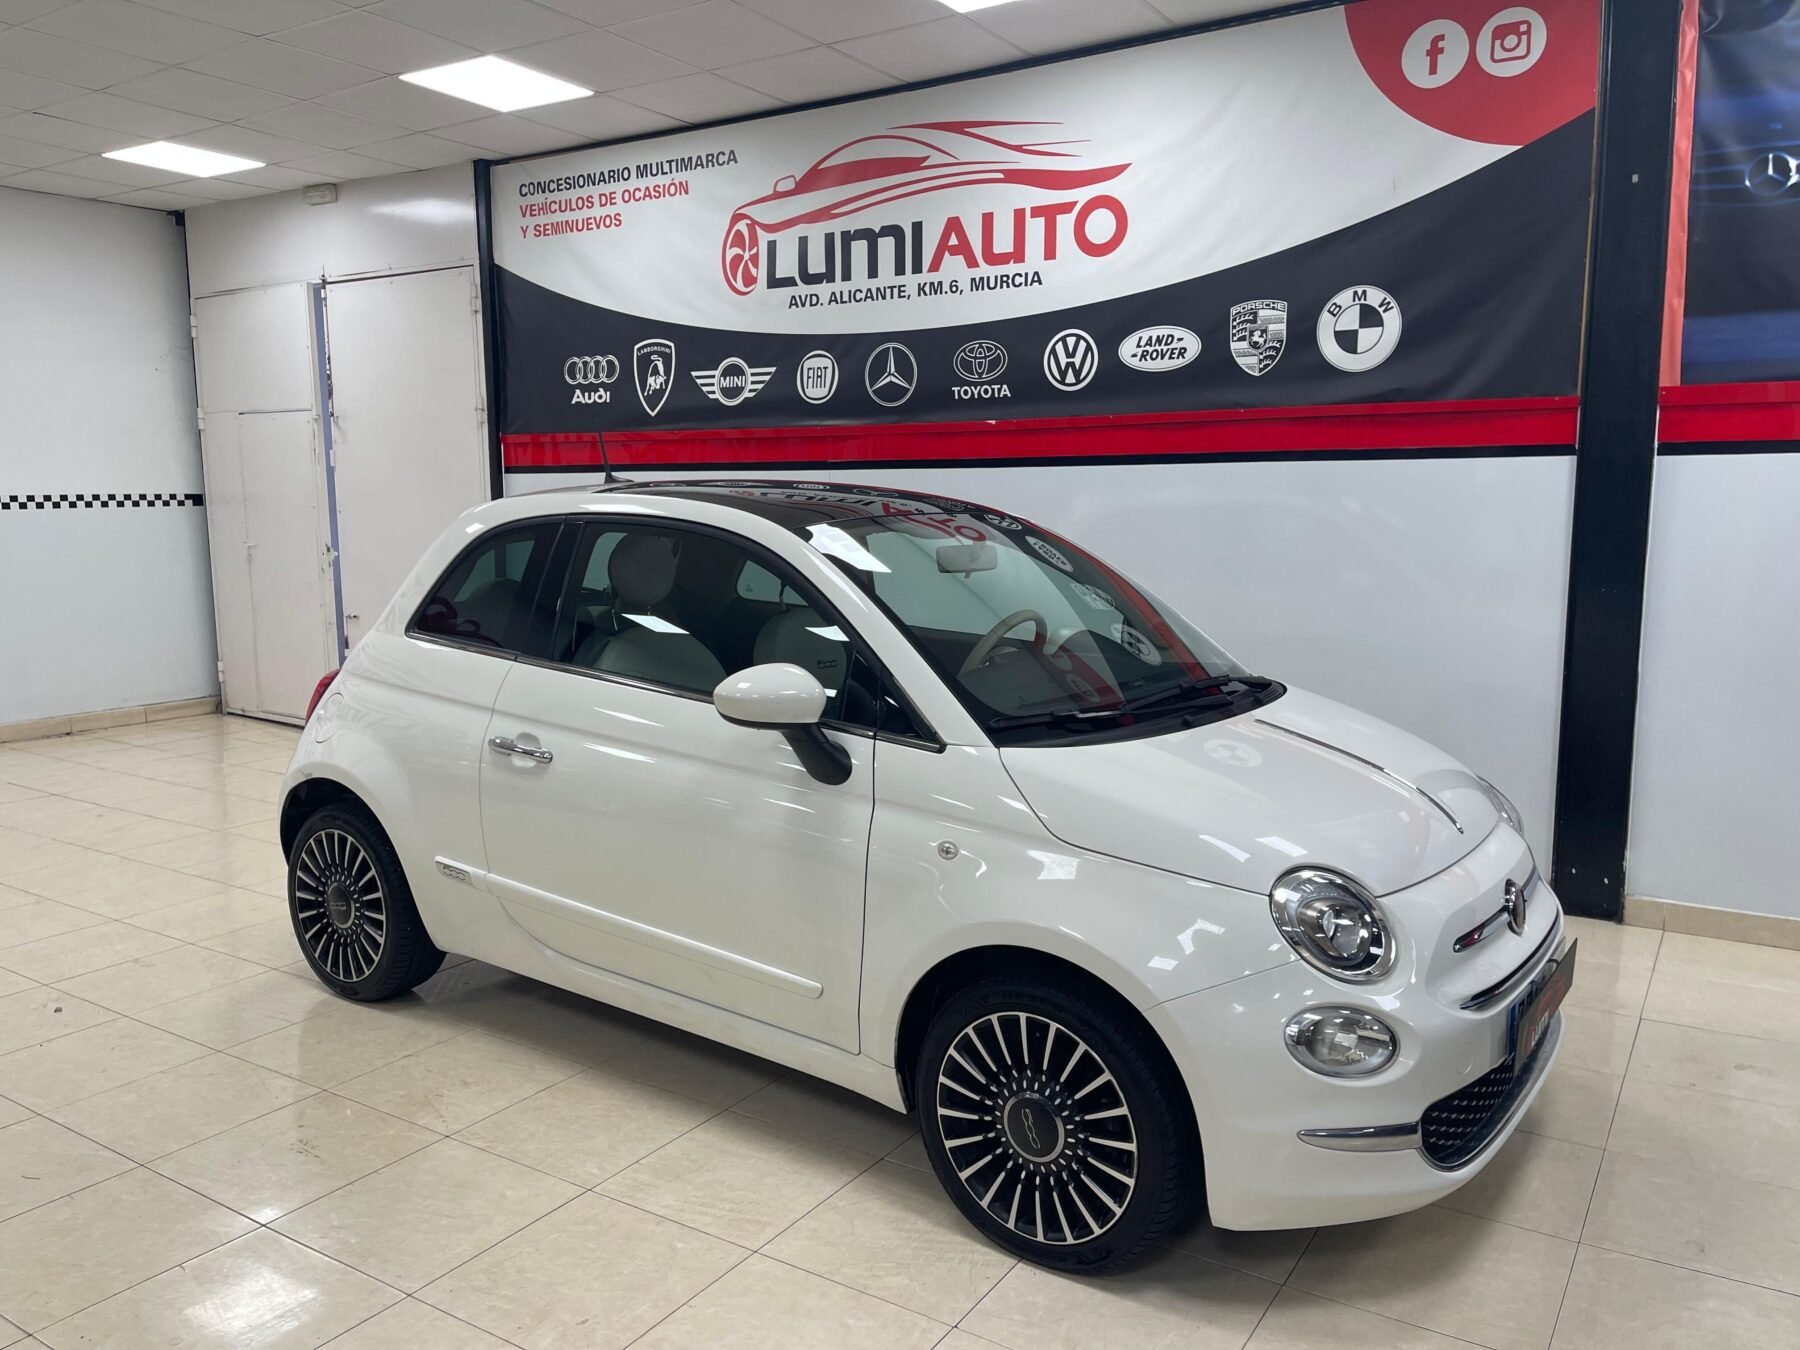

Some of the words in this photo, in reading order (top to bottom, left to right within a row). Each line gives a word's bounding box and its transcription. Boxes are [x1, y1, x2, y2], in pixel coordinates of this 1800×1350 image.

[519, 166, 631, 197] CONCESIONARIO
[635, 149, 739, 180] MULTIMARCA
[519, 195, 594, 218] VEHÍCULOS
[599, 191, 617, 207] DE
[621, 178, 690, 204] OCASIÓN
[520, 225, 530, 239] Y
[533, 213, 623, 238] SEMINUEVOS
[788, 293, 824, 310] AVD.
[828, 284, 912, 306] ALICANTE,
[917, 279, 964, 297] KM.6,
[969, 270, 1043, 292] MURCIA
[1231, 300, 1286, 316] PORSCHE
[1326, 288, 1395, 318] BMW
[1135, 332, 1176, 349] LAND
[1138, 346, 1188, 363] ROVER
[719, 375, 747, 389] MINI
[806, 366, 829, 389] FIAT
[571, 387, 611, 404] Audi
[951, 384, 1011, 400] TOYOTA
